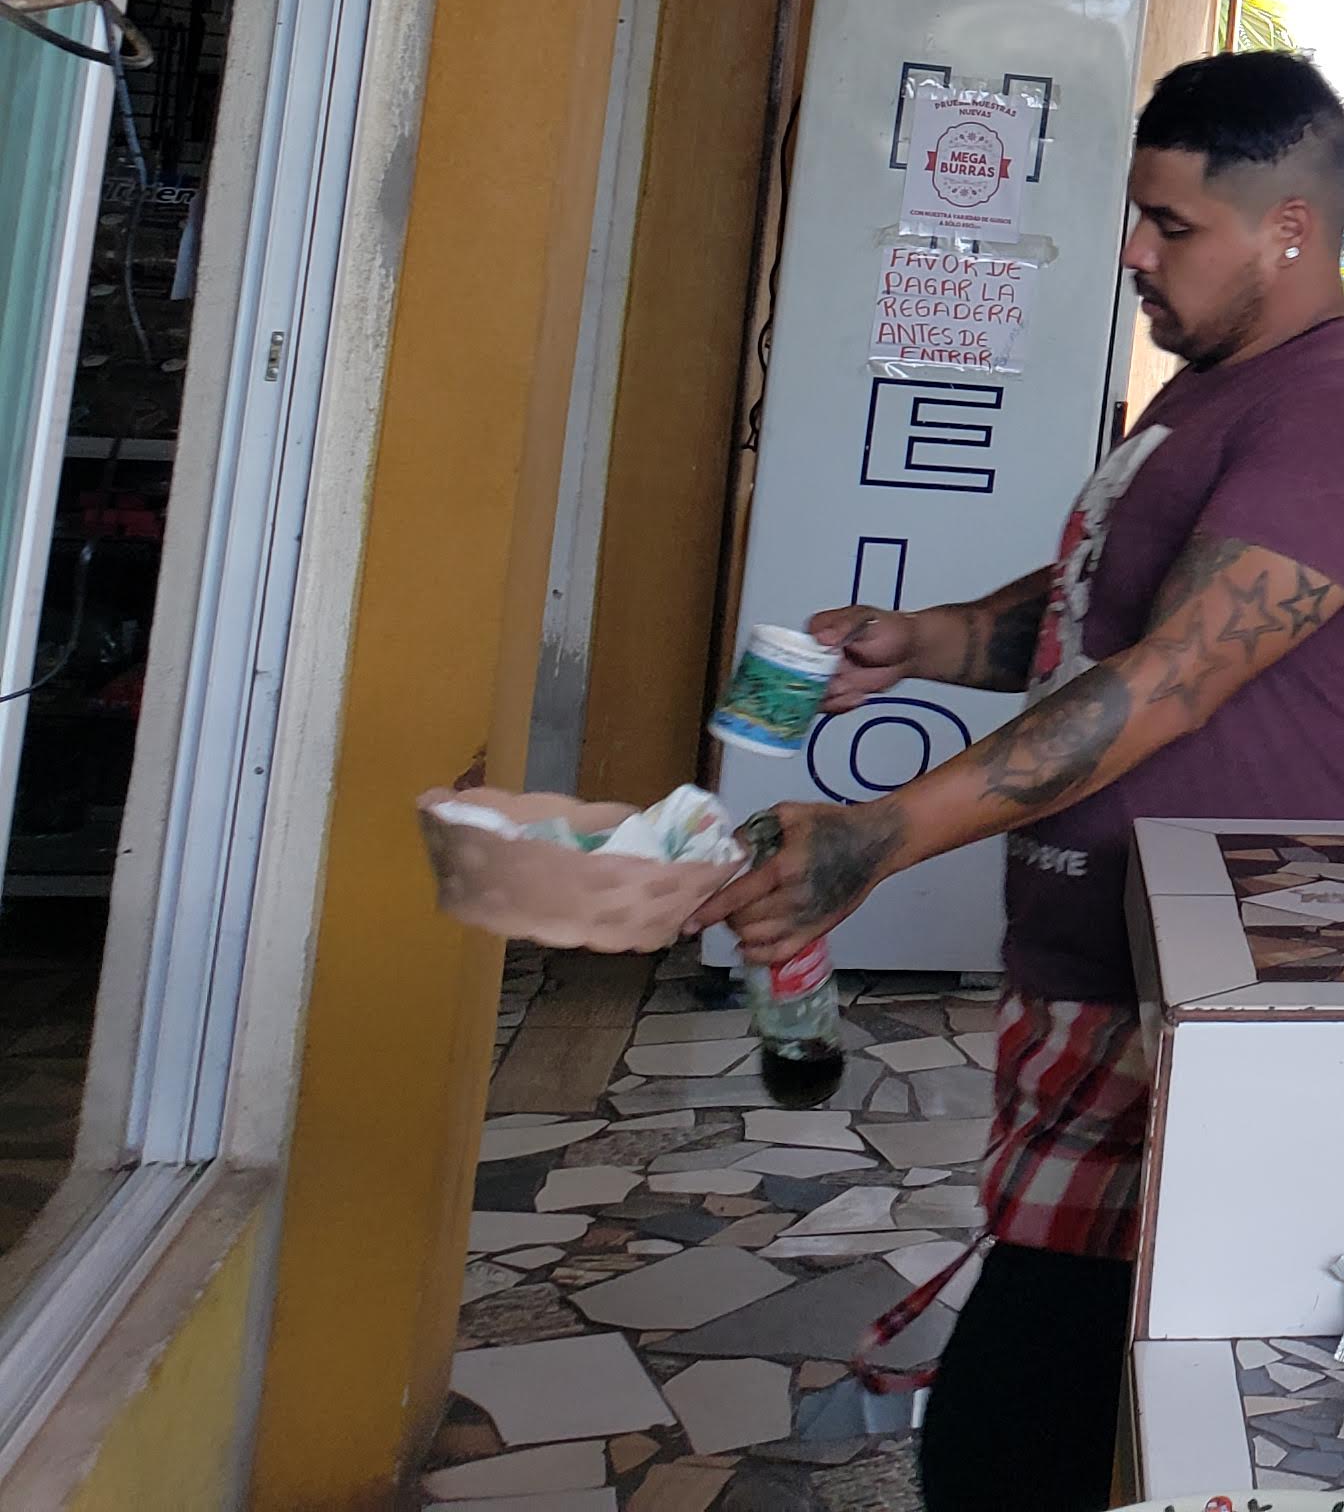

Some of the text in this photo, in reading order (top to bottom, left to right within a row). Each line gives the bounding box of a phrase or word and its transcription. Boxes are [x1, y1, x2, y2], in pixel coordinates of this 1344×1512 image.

[959, 109, 992, 118] NUEVAS
[972, 100, 1017, 117] NUESTRAS
[940, 162, 995, 178] BURRAS
[950, 151, 987, 165] MEGA
[890, 248, 1021, 280] FAVOR DE
[882, 272, 1015, 303] PAGAR LA
[877, 296, 1023, 324] REGADERA
[877, 322, 954, 346] ANTES
[959, 330, 988, 347] DE
[900, 346, 993, 372] ENTRAR
